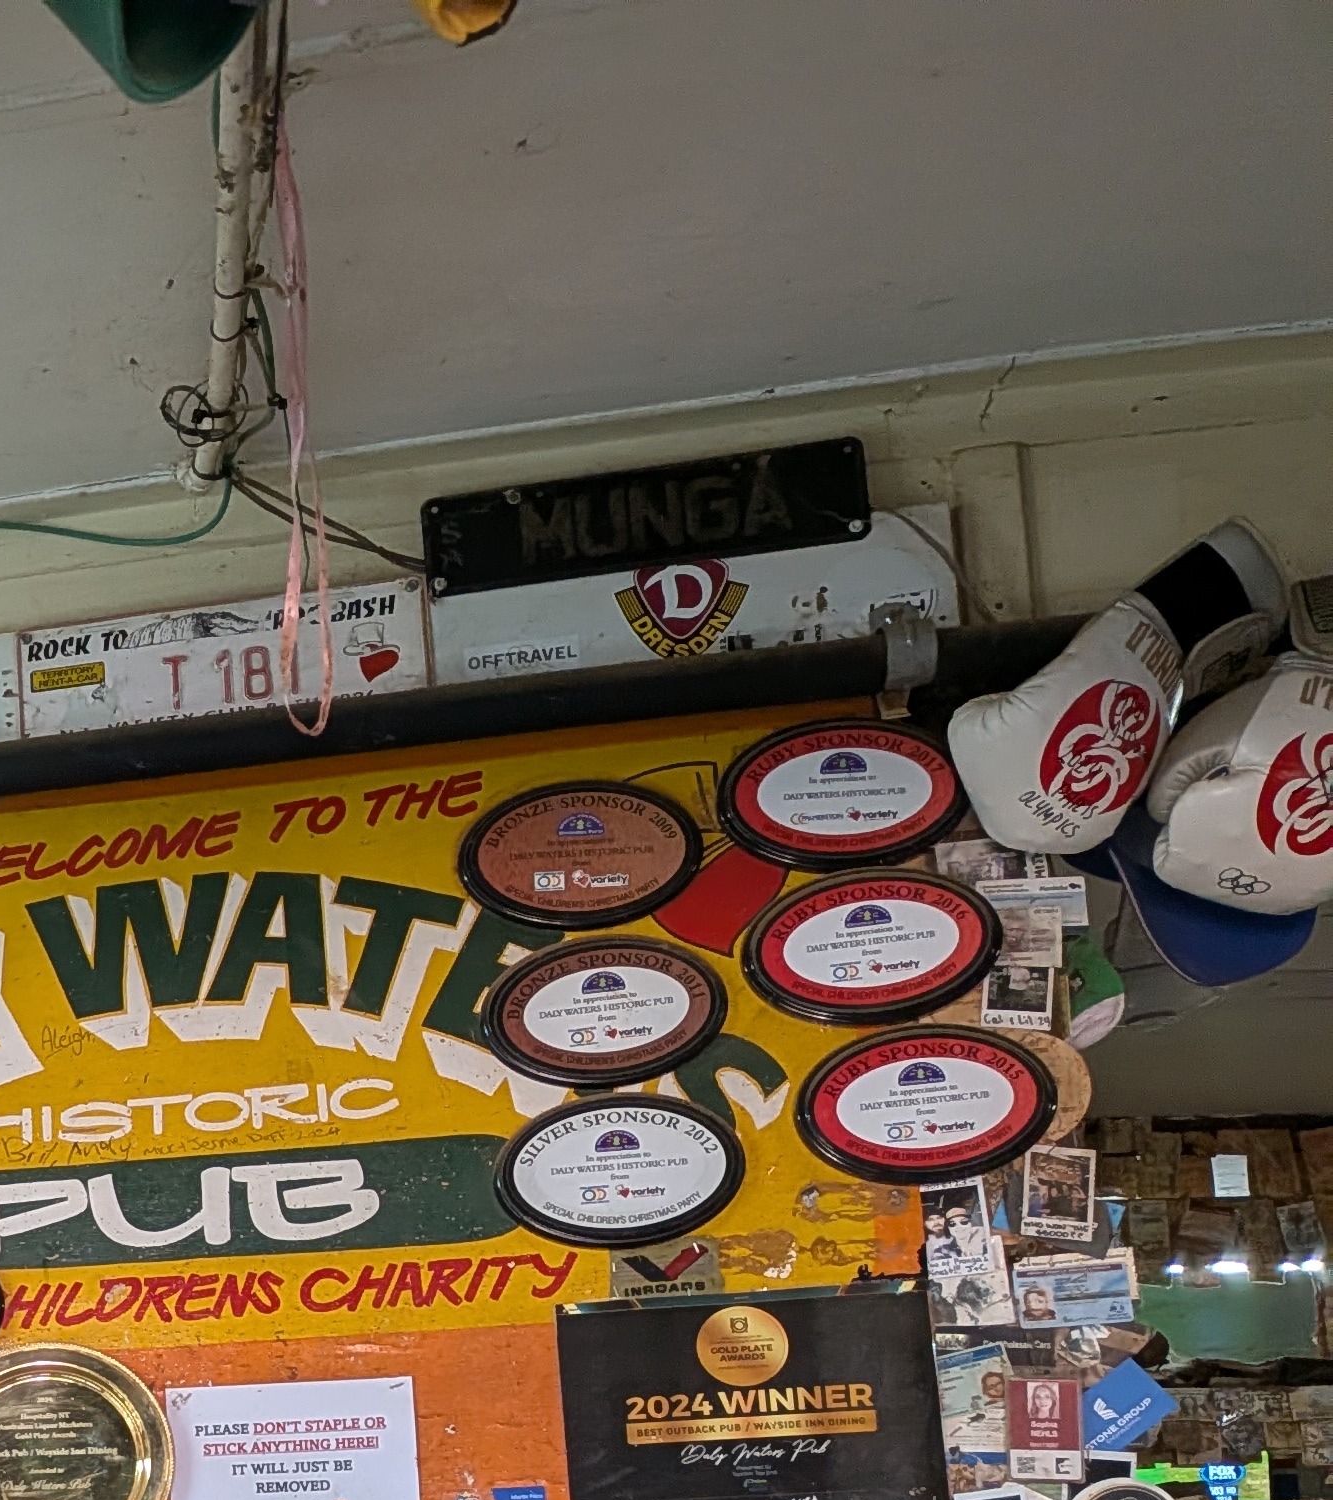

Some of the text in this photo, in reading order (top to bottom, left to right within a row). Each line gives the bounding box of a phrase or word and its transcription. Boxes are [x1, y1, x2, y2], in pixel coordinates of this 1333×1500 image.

[27, 634, 91, 662] ROCK
[101, 629, 128, 651] TO
[631, 611, 734, 657] DRESDEN
[467, 644, 579, 671] OFFTRAVEL
[272, 795, 348, 845] TO
[365, 770, 483, 824] THE
[823, 1043, 1025, 1097] RUBY SPONSOR 2015
[519, 1110, 719, 1167] SILVER SPONSOR 2012
[551, 1158, 688, 1176] DALY WATERS HISTORIC PUB
[1, 1250, 579, 1331] HILDRENS CHARITY
[624, 1280, 706, 1298] INROADS
[710, 1344, 773, 1355] GOLD PLATE
[720, 1353, 765, 1362] AWARDS
[626, 1383, 874, 1421] 2024 WINNER
[195, 1417, 387, 1436] PLEASE DON'T STAPLE OR
[637, 1428, 663, 1438] BEST
[667, 1425, 716, 1436] OUTBACK
[720, 1423, 741, 1433] PUB
[753, 1419, 802, 1431] WAYSIDE
[203, 1443, 248, 1455] STICK
[251, 1439, 331, 1454] ANYTHING
[681, 1439, 831, 1466] Daly Waters Pub
[232, 1460, 353, 1476] IT WILL JUST BE
[256, 1481, 331, 1493] REMOVED
